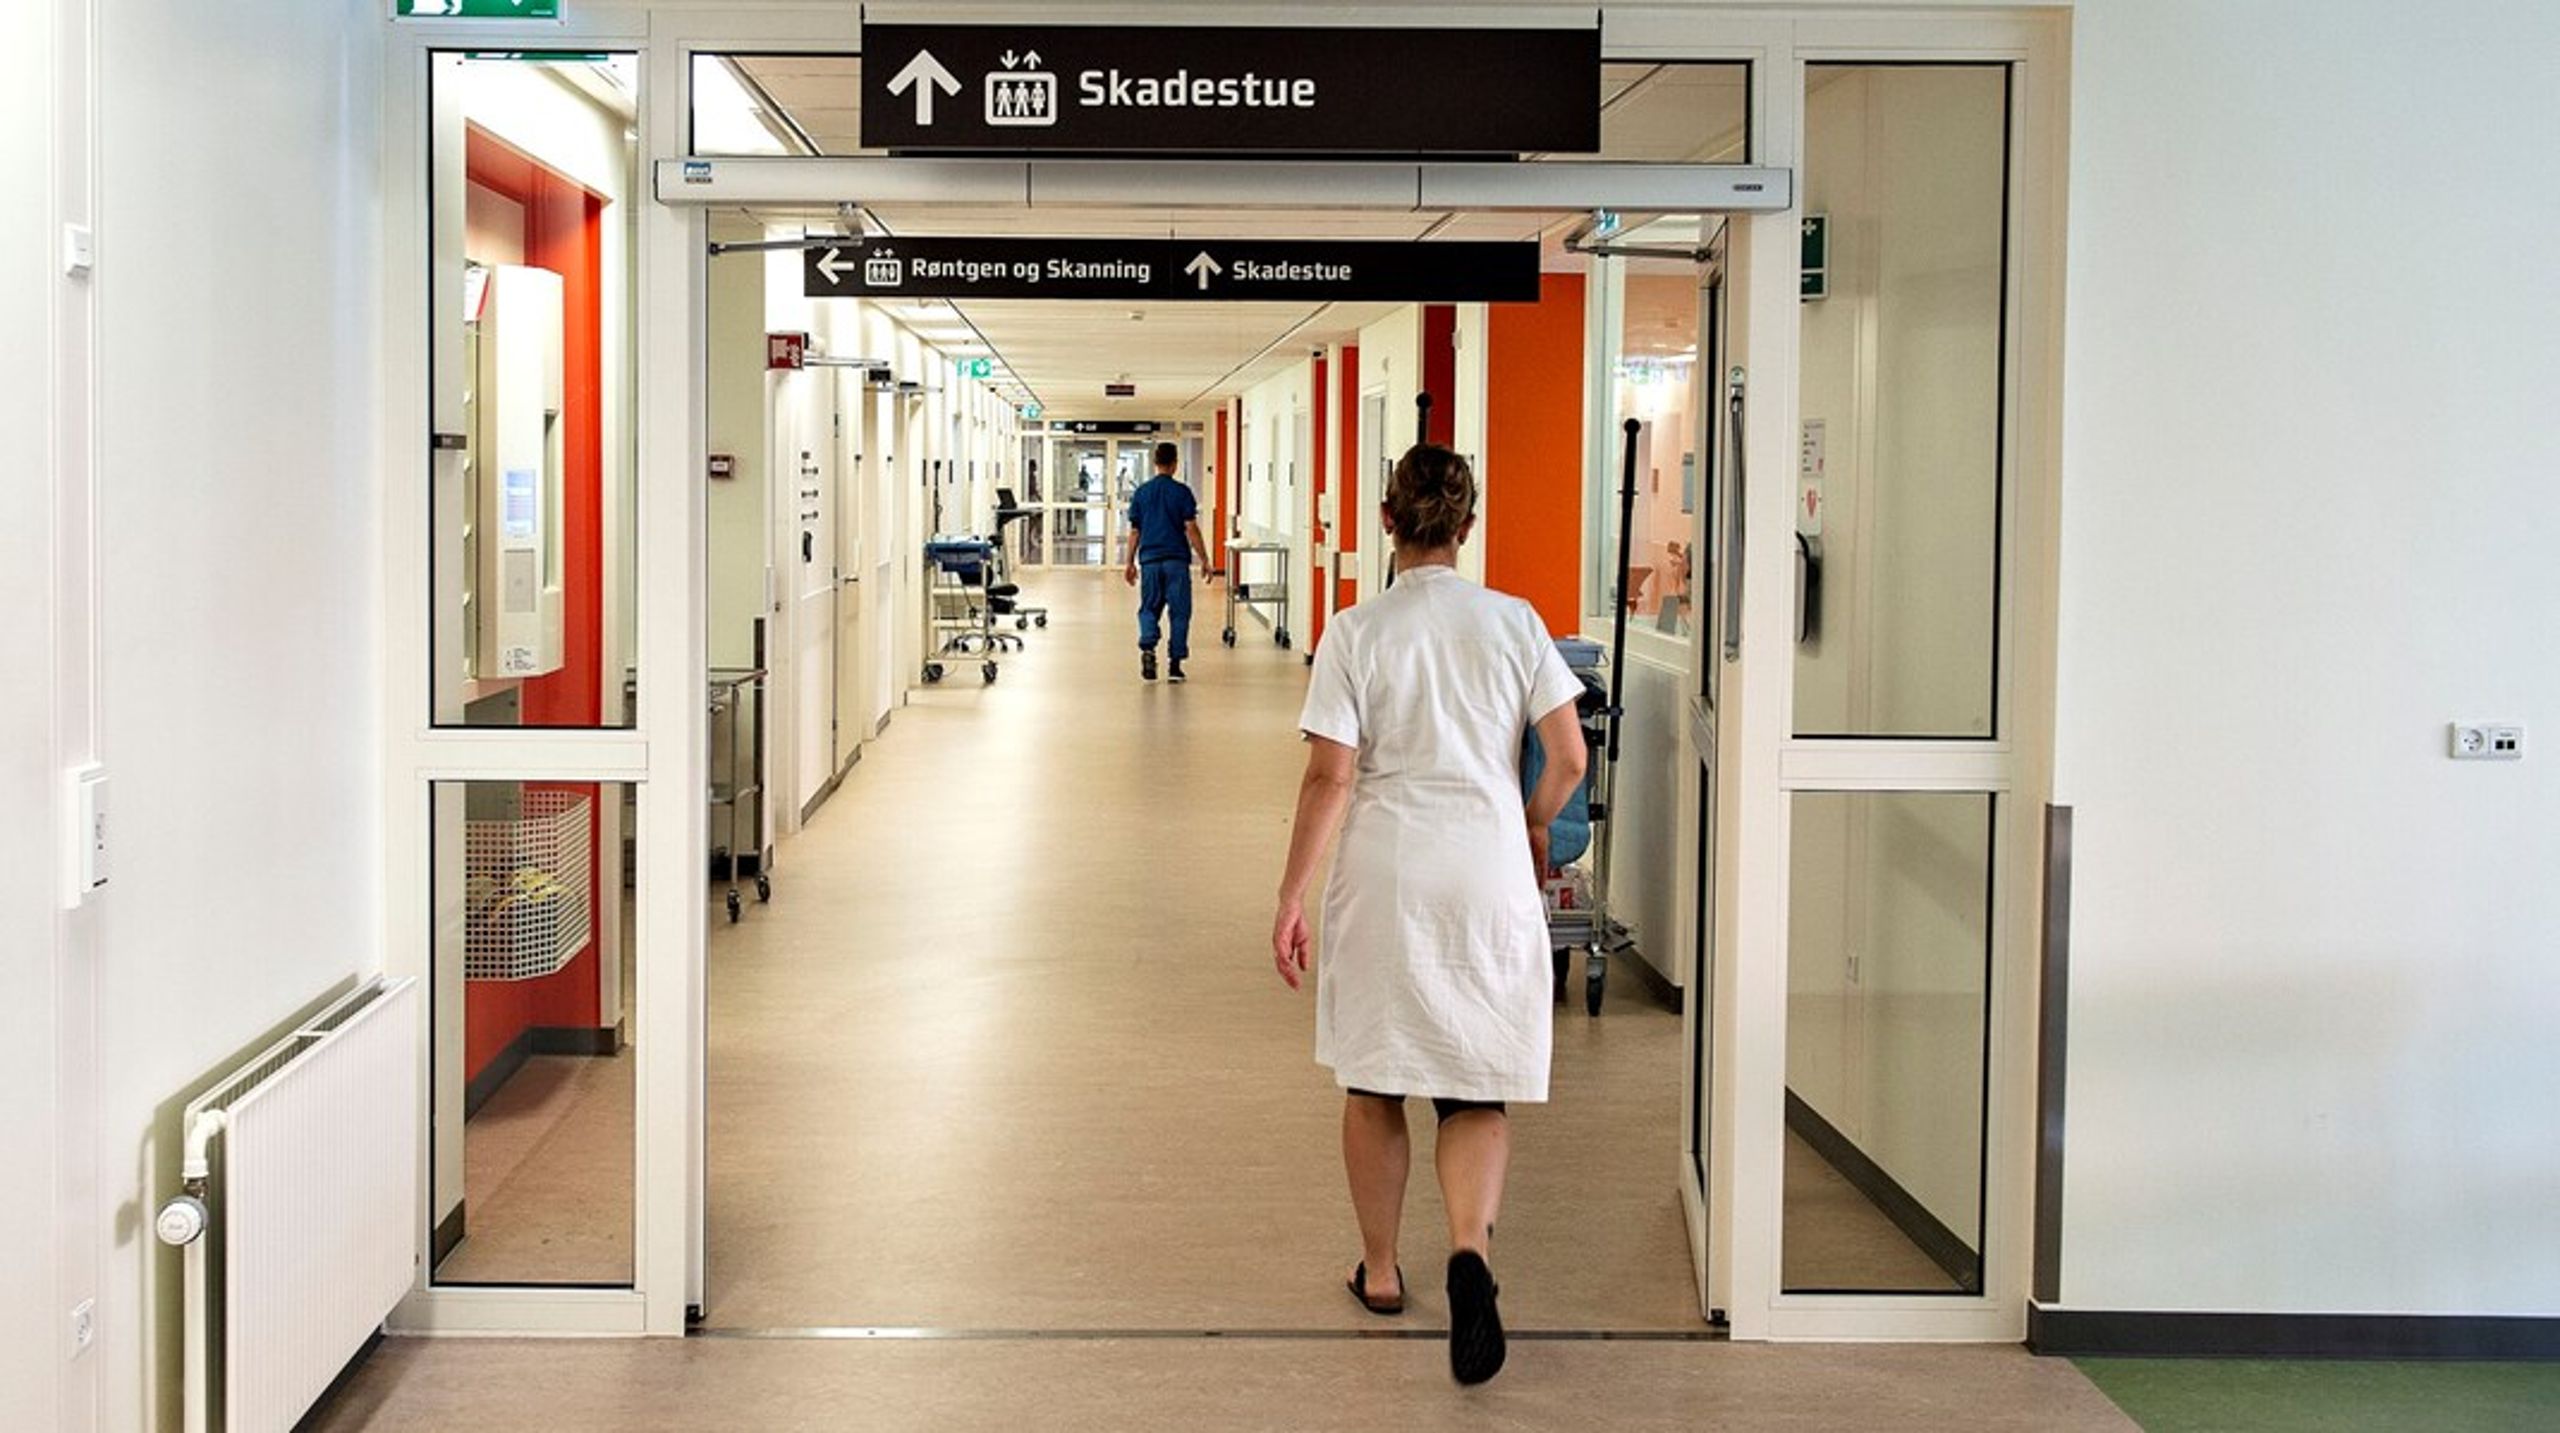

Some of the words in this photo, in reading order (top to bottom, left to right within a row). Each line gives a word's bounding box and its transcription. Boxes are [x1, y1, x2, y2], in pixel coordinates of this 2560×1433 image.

[1079, 69, 1315, 108] Skadestue
[912, 258, 1006, 283] Røntgen
[1014, 263, 1039, 283] og
[1047, 259, 1151, 283] Skanning
[1233, 260, 1352, 281] Skadestue
